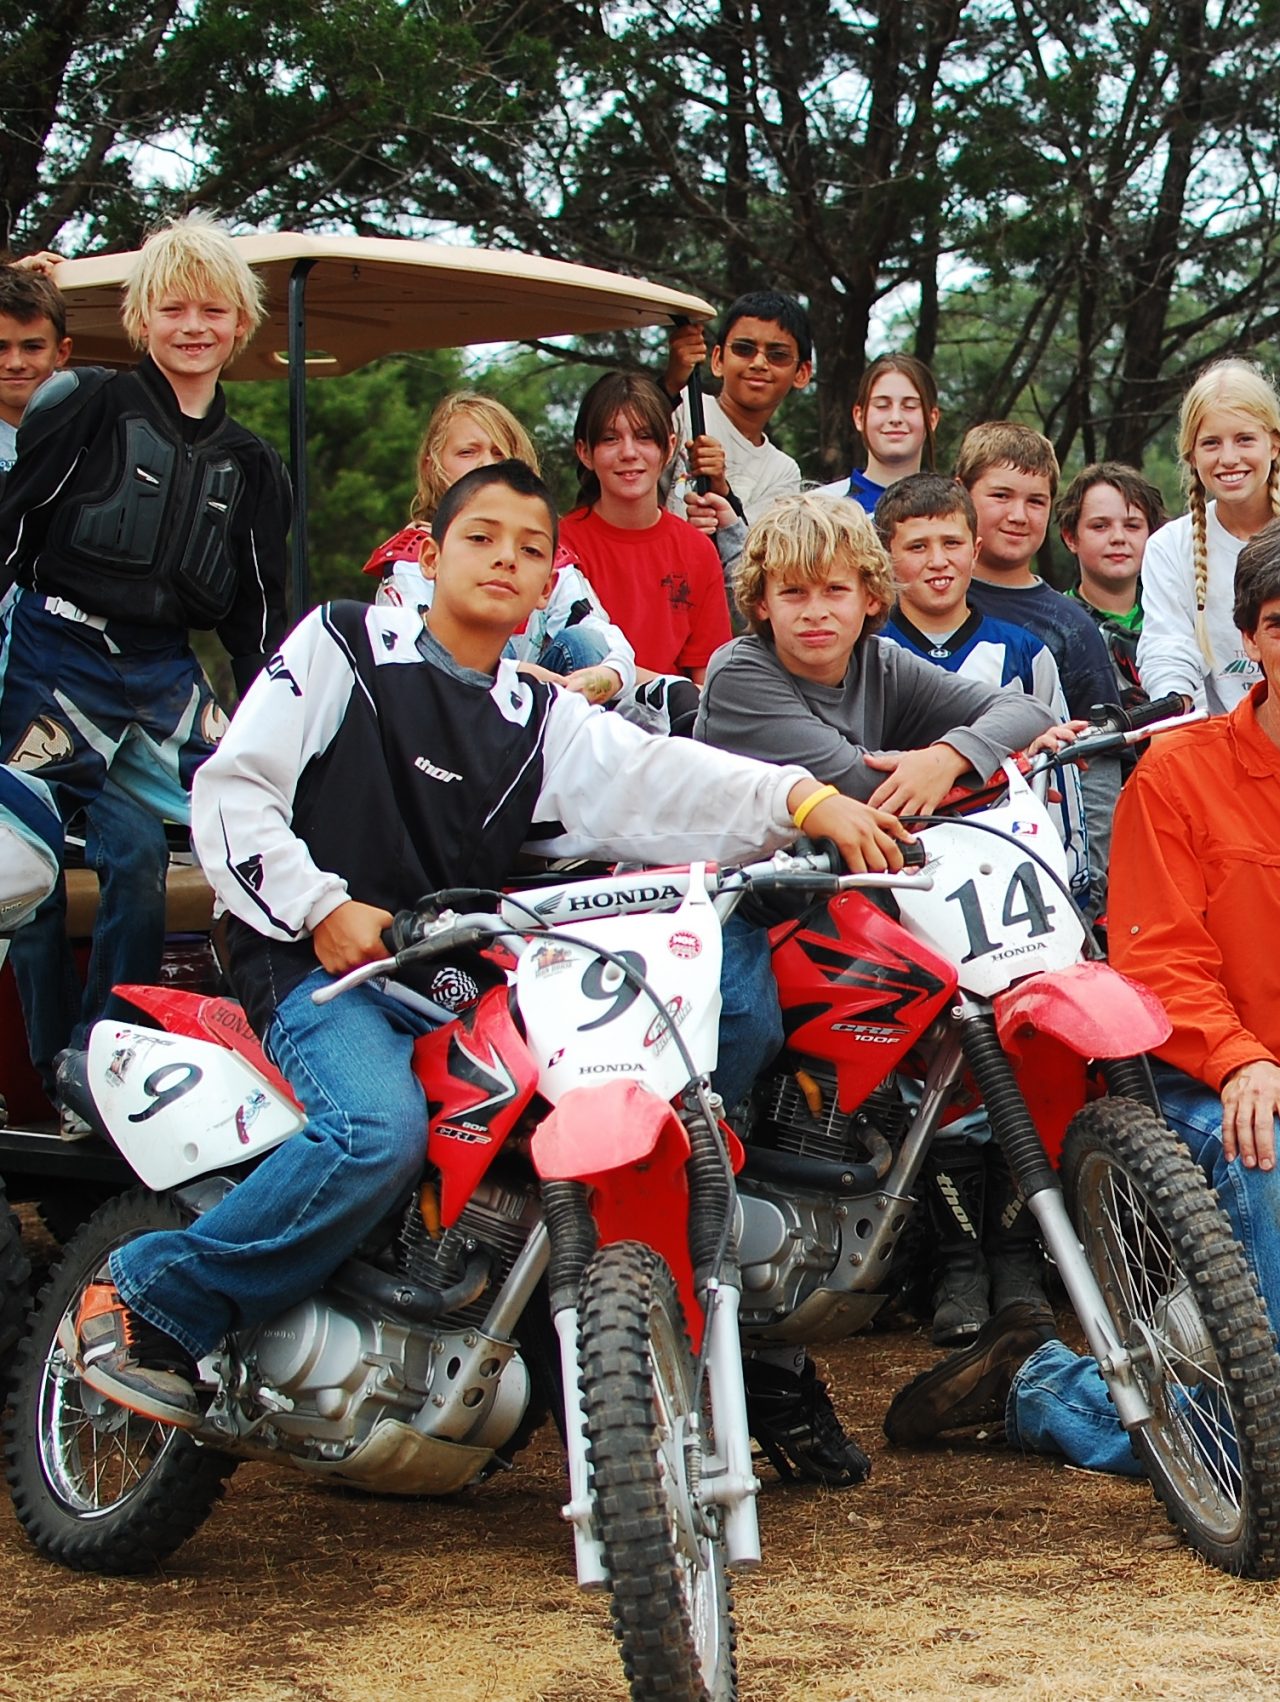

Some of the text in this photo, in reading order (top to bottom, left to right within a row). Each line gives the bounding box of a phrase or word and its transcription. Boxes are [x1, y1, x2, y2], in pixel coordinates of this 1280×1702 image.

[414, 755, 464, 784] thor
[568, 884, 685, 912] HONDA
[944, 861, 1057, 964] 14
[991, 941, 1049, 962] HONDA
[576, 950, 648, 1032] 9
[829, 1023, 912, 1036] CRF
[854, 1034, 901, 1044] 100F
[578, 1063, 647, 1076] HONDA
[127, 1062, 204, 1123] 9
[434, 1126, 492, 1146] CRF
[936, 1172, 977, 1240] thor
